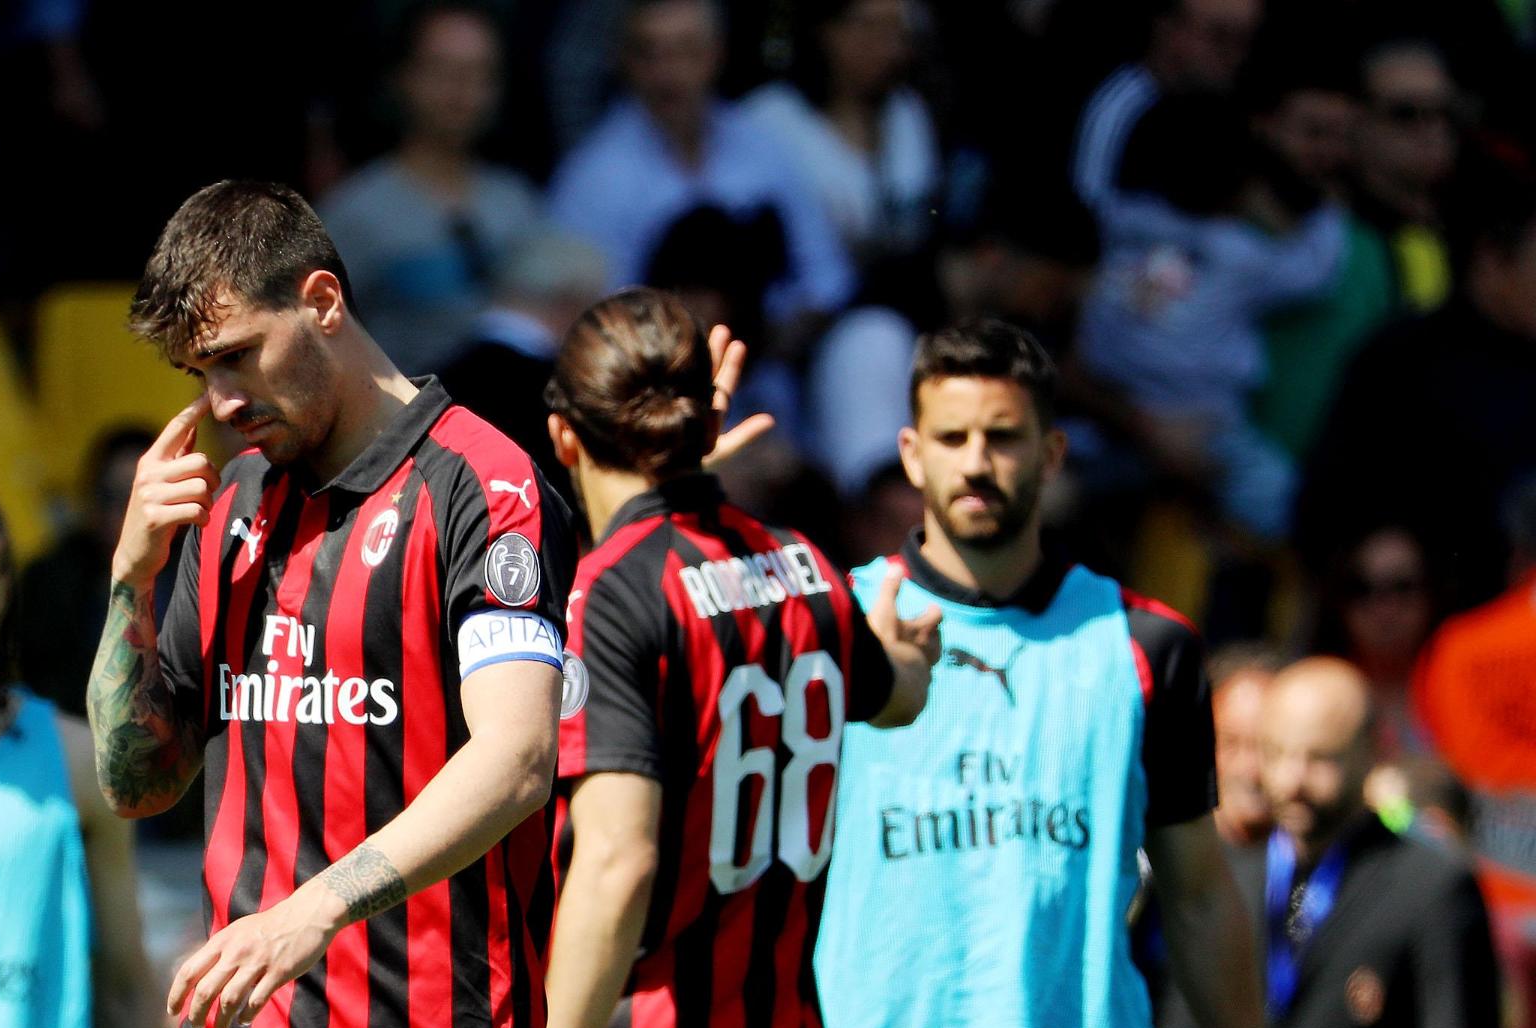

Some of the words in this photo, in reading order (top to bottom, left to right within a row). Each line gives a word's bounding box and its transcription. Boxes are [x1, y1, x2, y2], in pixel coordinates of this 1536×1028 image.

[507, 566, 520, 586] 7
[262, 614, 316, 667] Fly
[219, 659, 398, 726] Emirates
[709, 650, 846, 895] 68
[957, 750, 1021, 786] Fly
[881, 793, 1091, 860] Emirates
